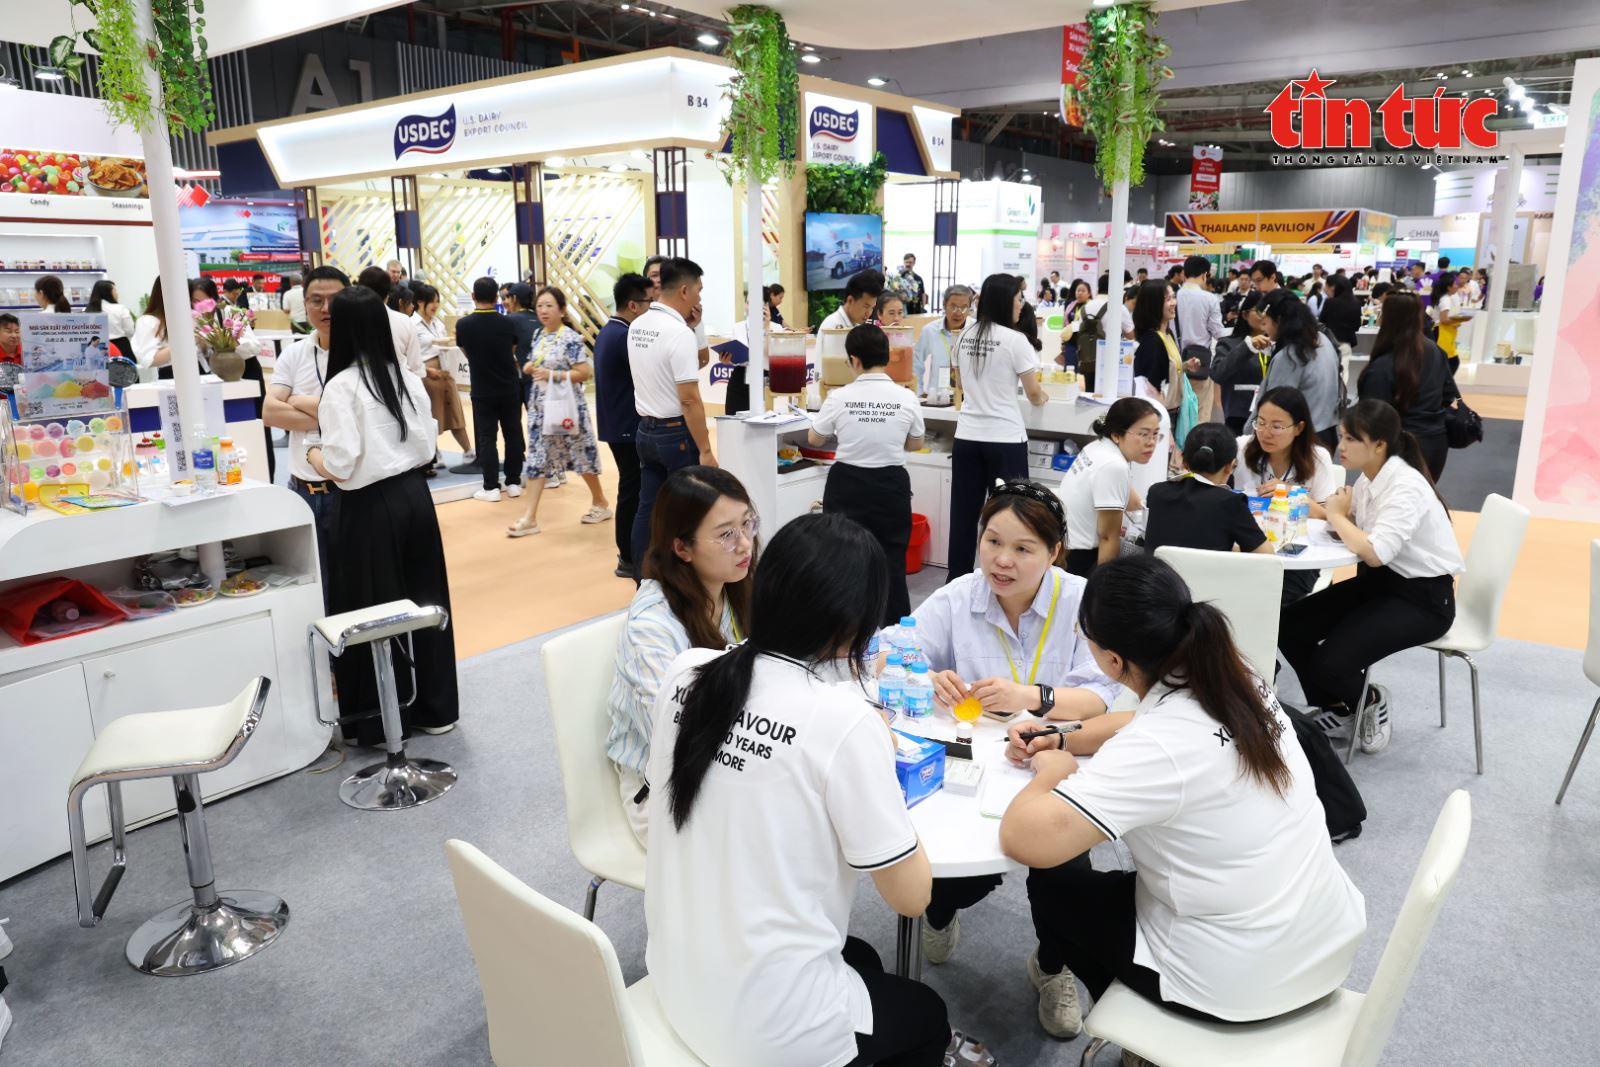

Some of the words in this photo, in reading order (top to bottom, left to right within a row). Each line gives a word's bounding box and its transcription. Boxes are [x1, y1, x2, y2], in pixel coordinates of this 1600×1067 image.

[290, 53, 374, 115] A1
[687, 95, 694, 107] B
[813, 111, 856, 132] USDEC
[398, 118, 452, 144] USDEC
[30, 198, 50, 207] Candy
[111, 201, 144, 210] Seasonings
[1200, 223, 1256, 233] THAILAND
[1260, 222, 1316, 232] PAVILION
[1410, 229, 1439, 238] CHINA
[844, 401, 867, 409] XUMEI
[868, 402, 902, 410] FLAVOUR
[733, 710, 797, 745] AVOUR
[735, 734, 773, 760] YEARS
